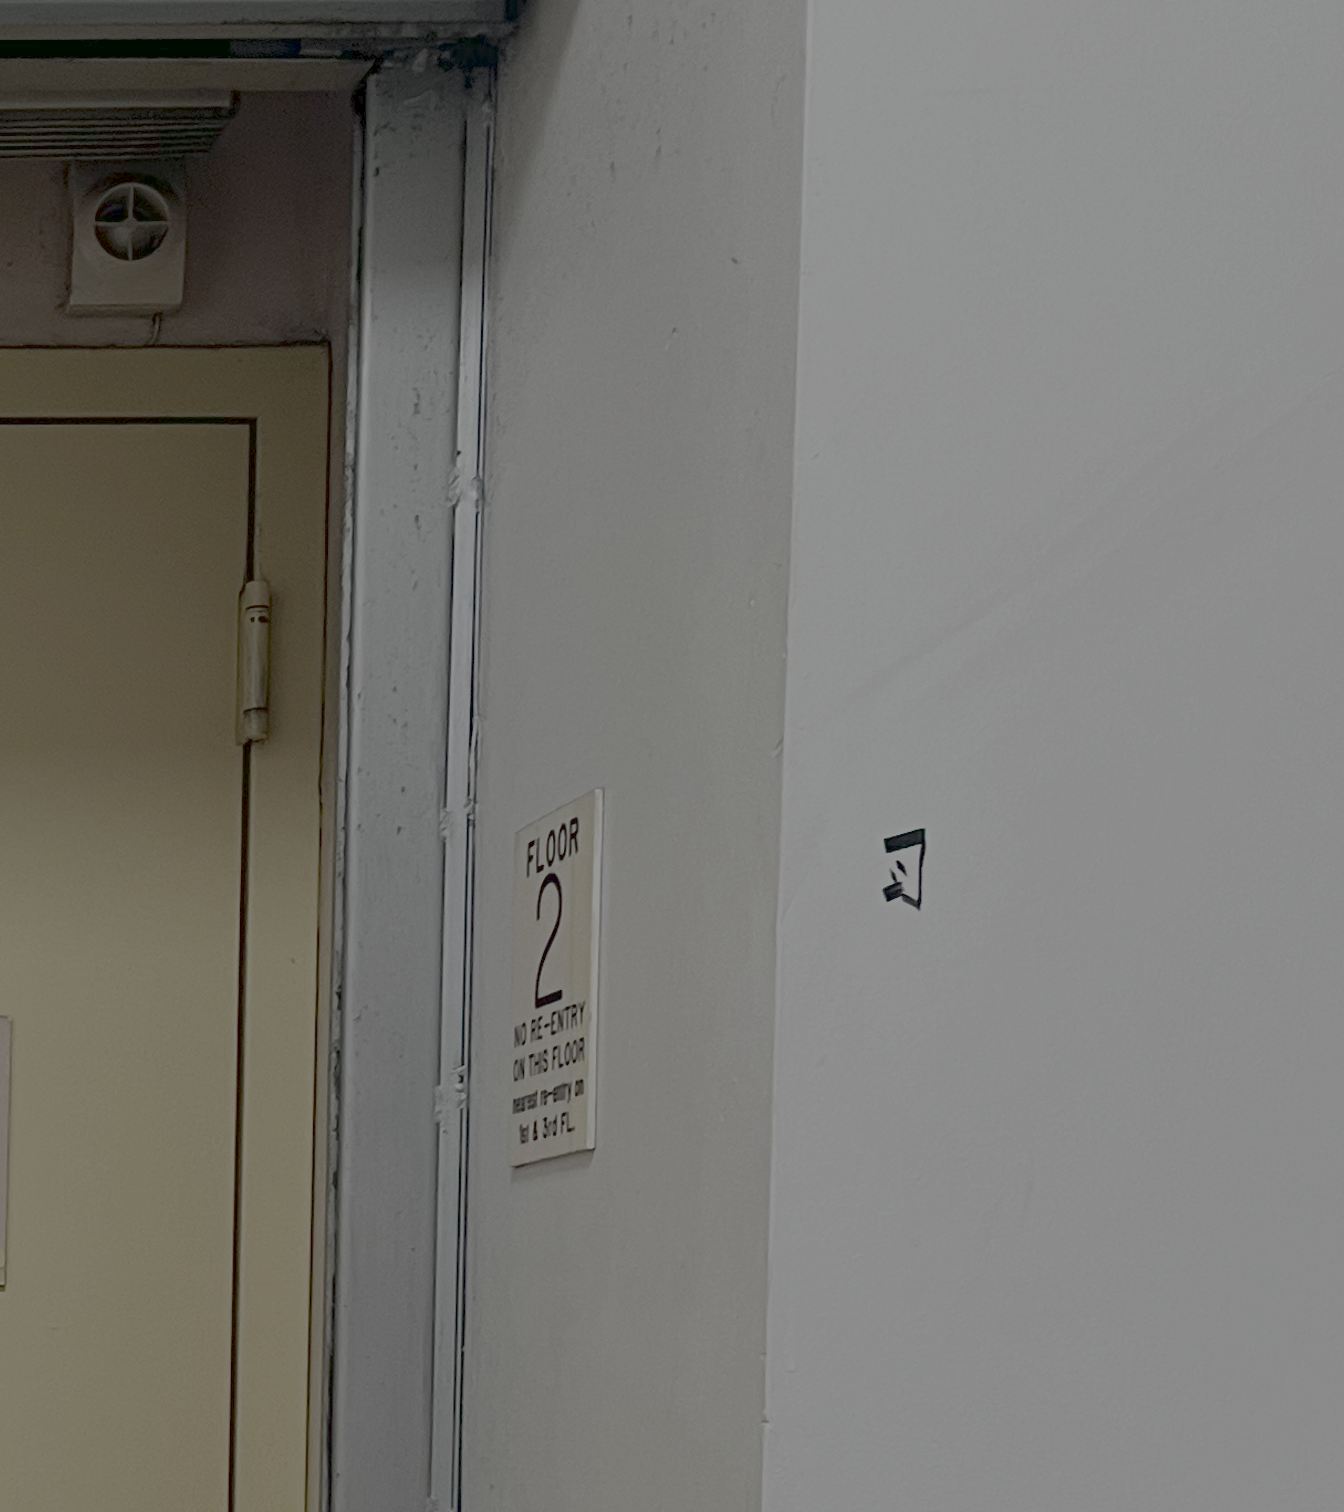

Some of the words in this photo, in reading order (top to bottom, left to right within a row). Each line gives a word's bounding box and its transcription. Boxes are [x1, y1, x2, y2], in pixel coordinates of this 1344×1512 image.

[526, 817, 579, 878] FLOOR
[535, 872, 563, 1009] 2
[514, 1022, 527, 1048] NO
[530, 1001, 586, 1043] RE-ENTRY
[513, 1057, 526, 1082] ON
[529, 1048, 548, 1077] THIS
[552, 1037, 585, 1071] FLOOR
[543, 1115, 557, 1139] 3rd
